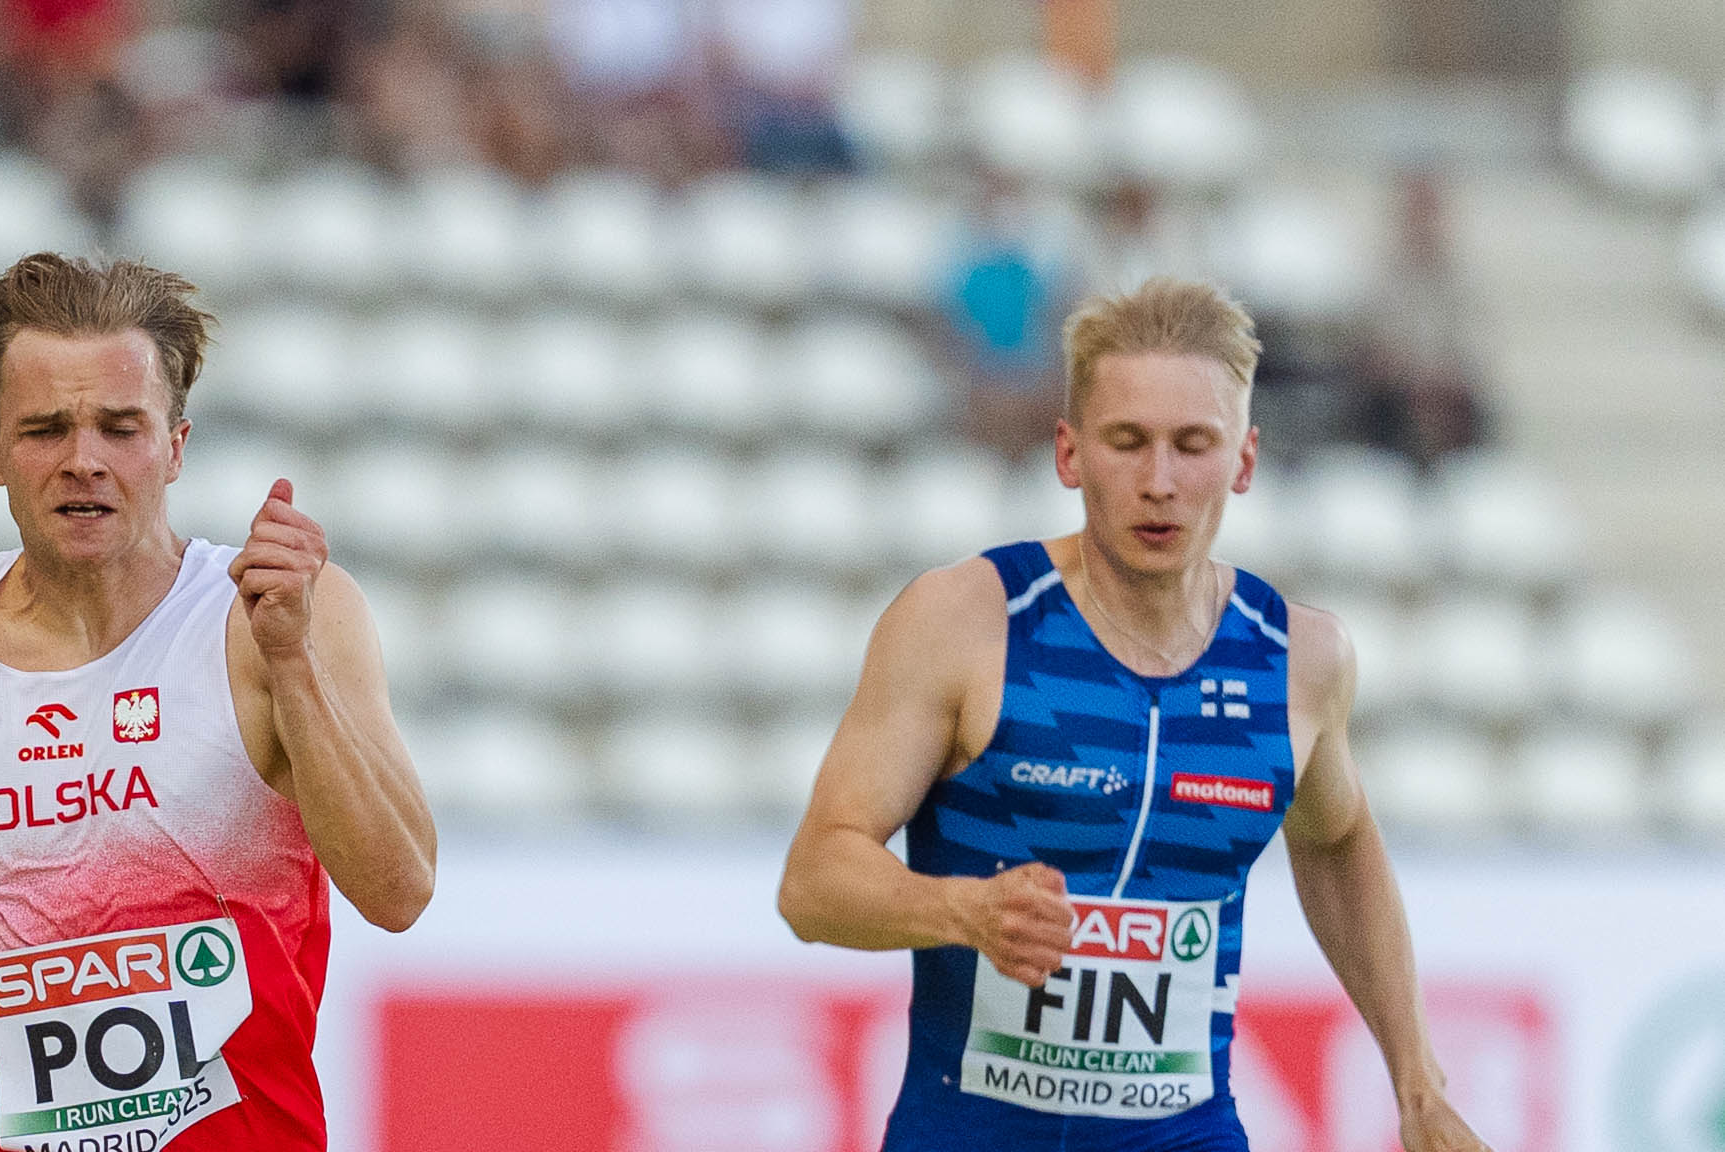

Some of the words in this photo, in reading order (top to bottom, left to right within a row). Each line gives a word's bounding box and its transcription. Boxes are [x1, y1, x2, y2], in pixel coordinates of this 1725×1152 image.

[18, 743, 84, 762] ORLEN
[1010, 761, 1106, 789] CRAFT
[1176, 780, 1271, 807] motonet
[1071, 909, 1163, 956] AR
[1024, 966, 1172, 1045] FIN
[25, 1000, 211, 1104] POL
[1029, 1043, 1079, 1067] RUN
[984, 1063, 1113, 1106] MADRID
[1120, 1083, 1192, 1110] 2025
[55, 1109, 63, 1129] I
[66, 1103, 114, 1126] RUN
